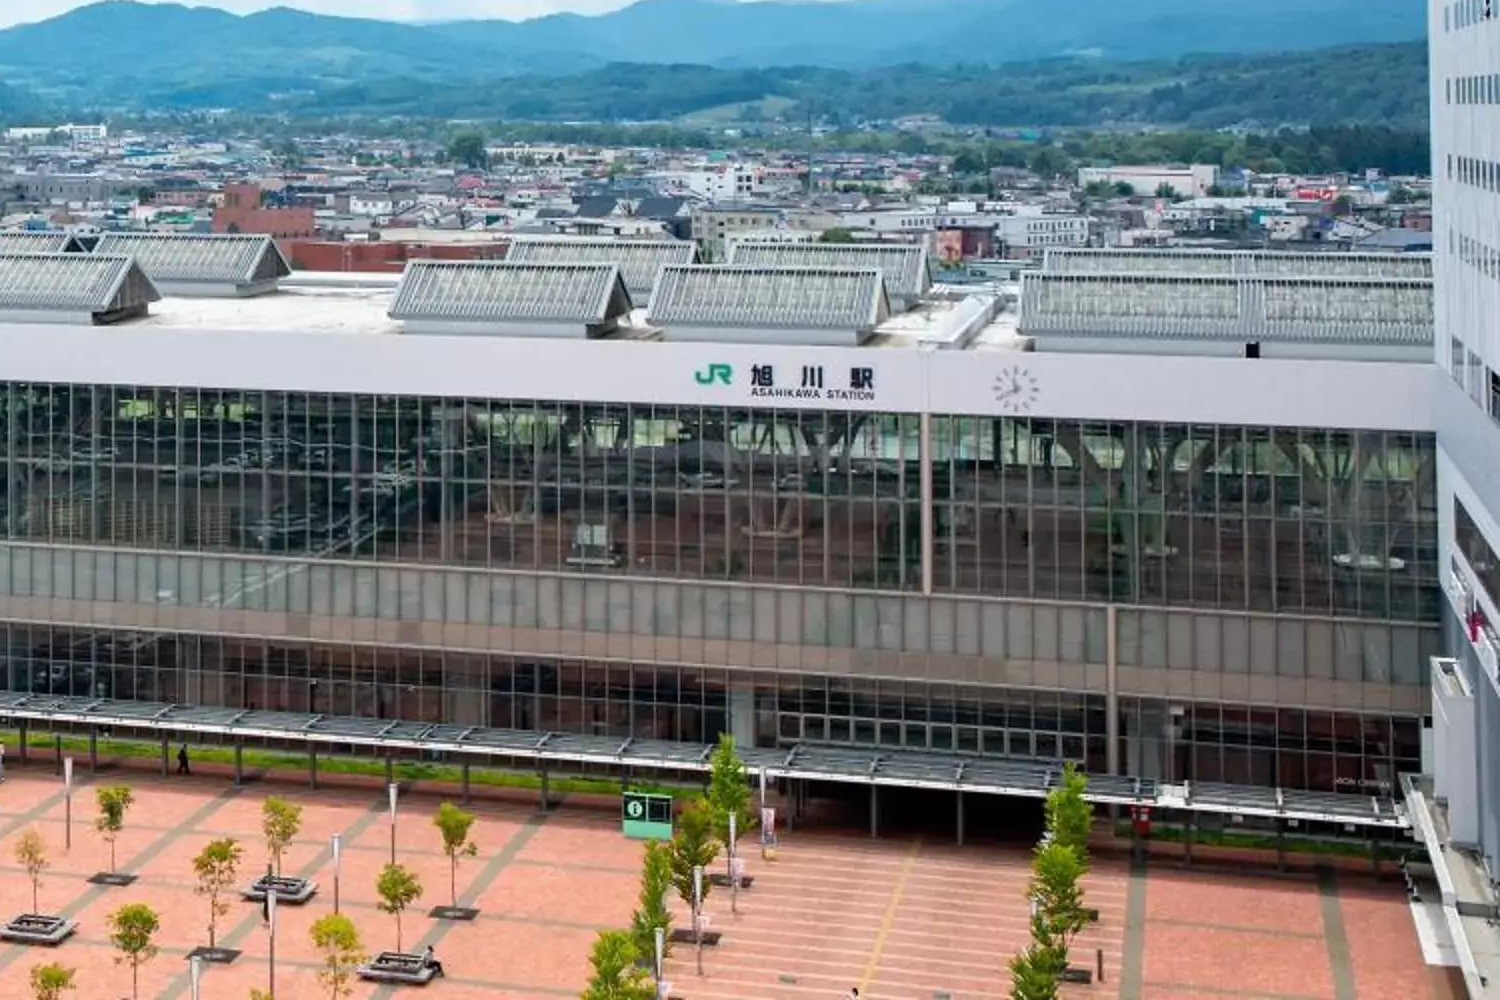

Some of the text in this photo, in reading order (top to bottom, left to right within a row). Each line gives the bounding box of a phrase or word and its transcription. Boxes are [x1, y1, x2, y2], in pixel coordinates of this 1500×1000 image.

[695, 363, 873, 389] JR 旭川駅
[751, 387, 875, 401] ASAHIKAWA STATION
